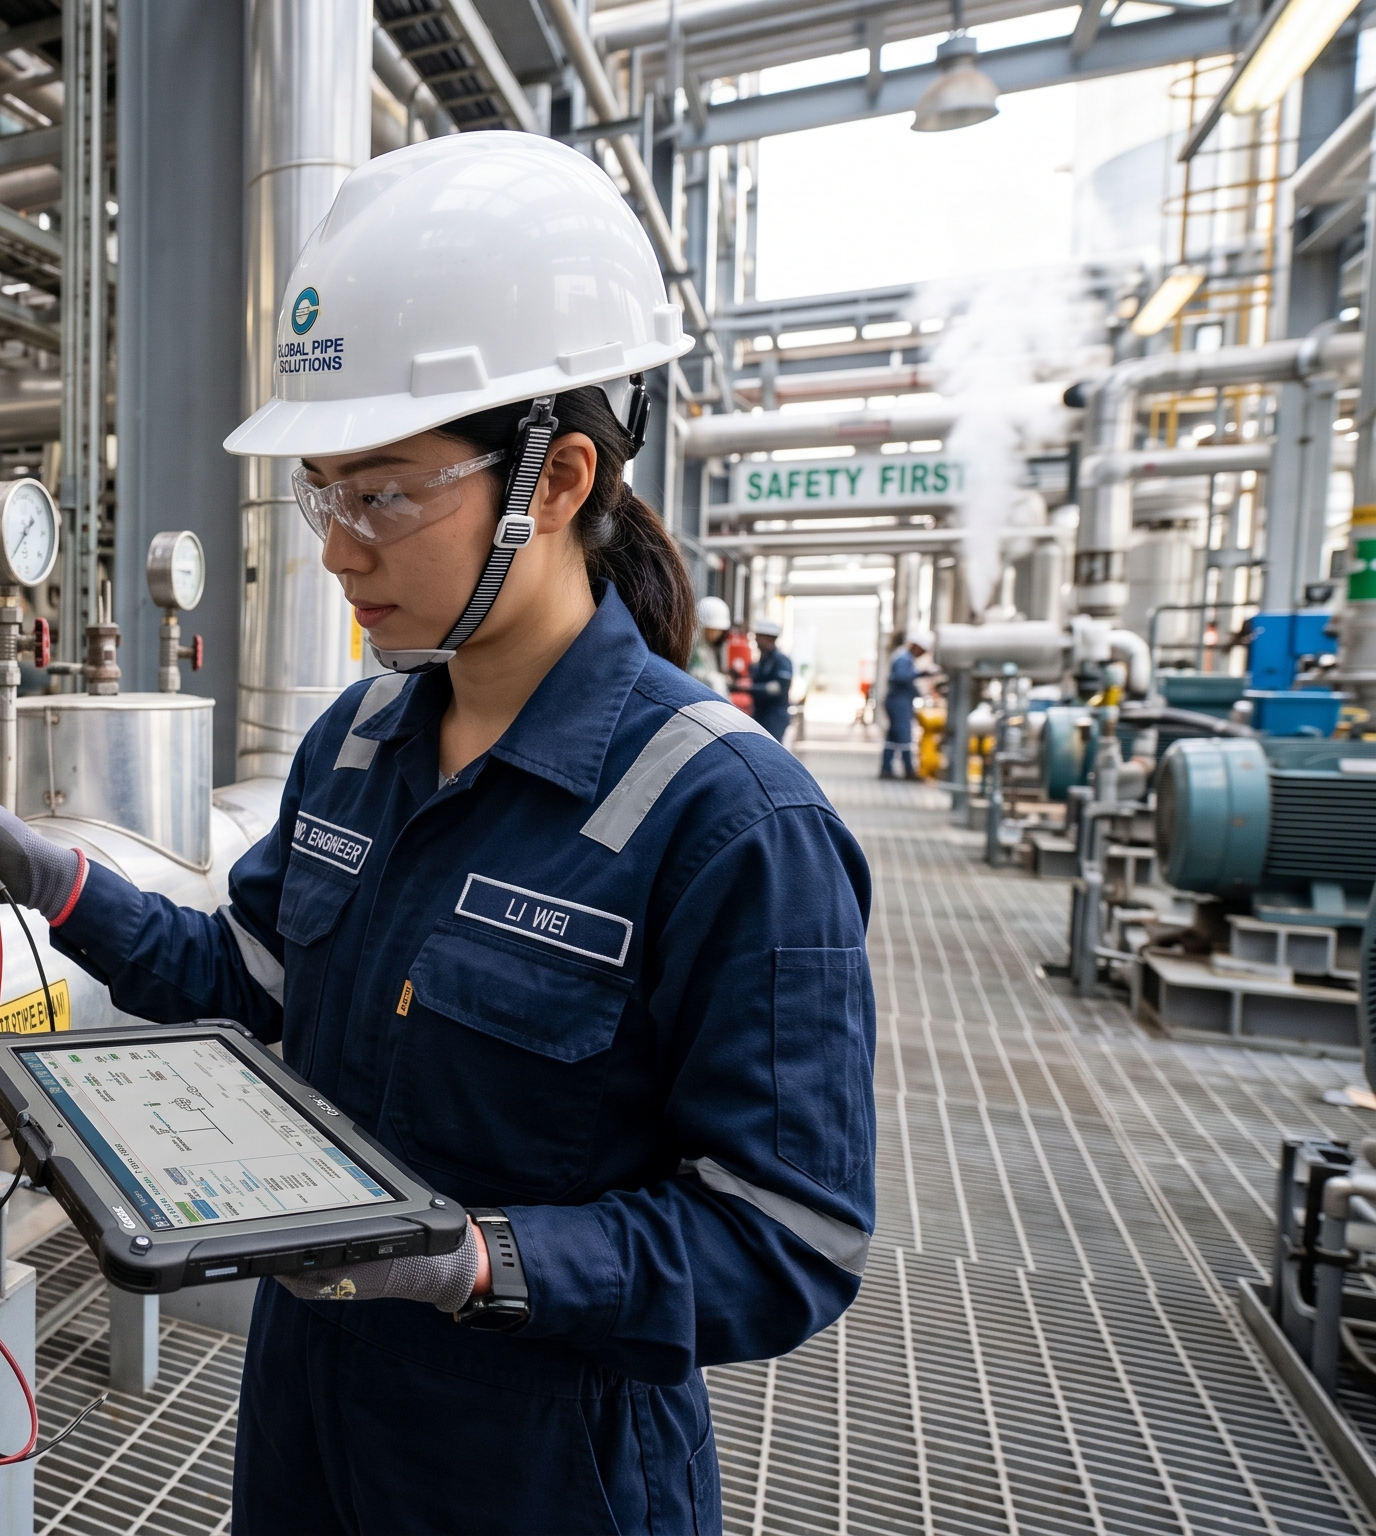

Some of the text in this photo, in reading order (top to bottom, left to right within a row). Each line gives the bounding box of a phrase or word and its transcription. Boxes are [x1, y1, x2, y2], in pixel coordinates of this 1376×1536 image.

[312, 338, 344, 355] PIPE
[280, 355, 343, 374] SOLUTIONS
[747, 466, 862, 501] SAFETY
[504, 898, 571, 936] LI WEI
